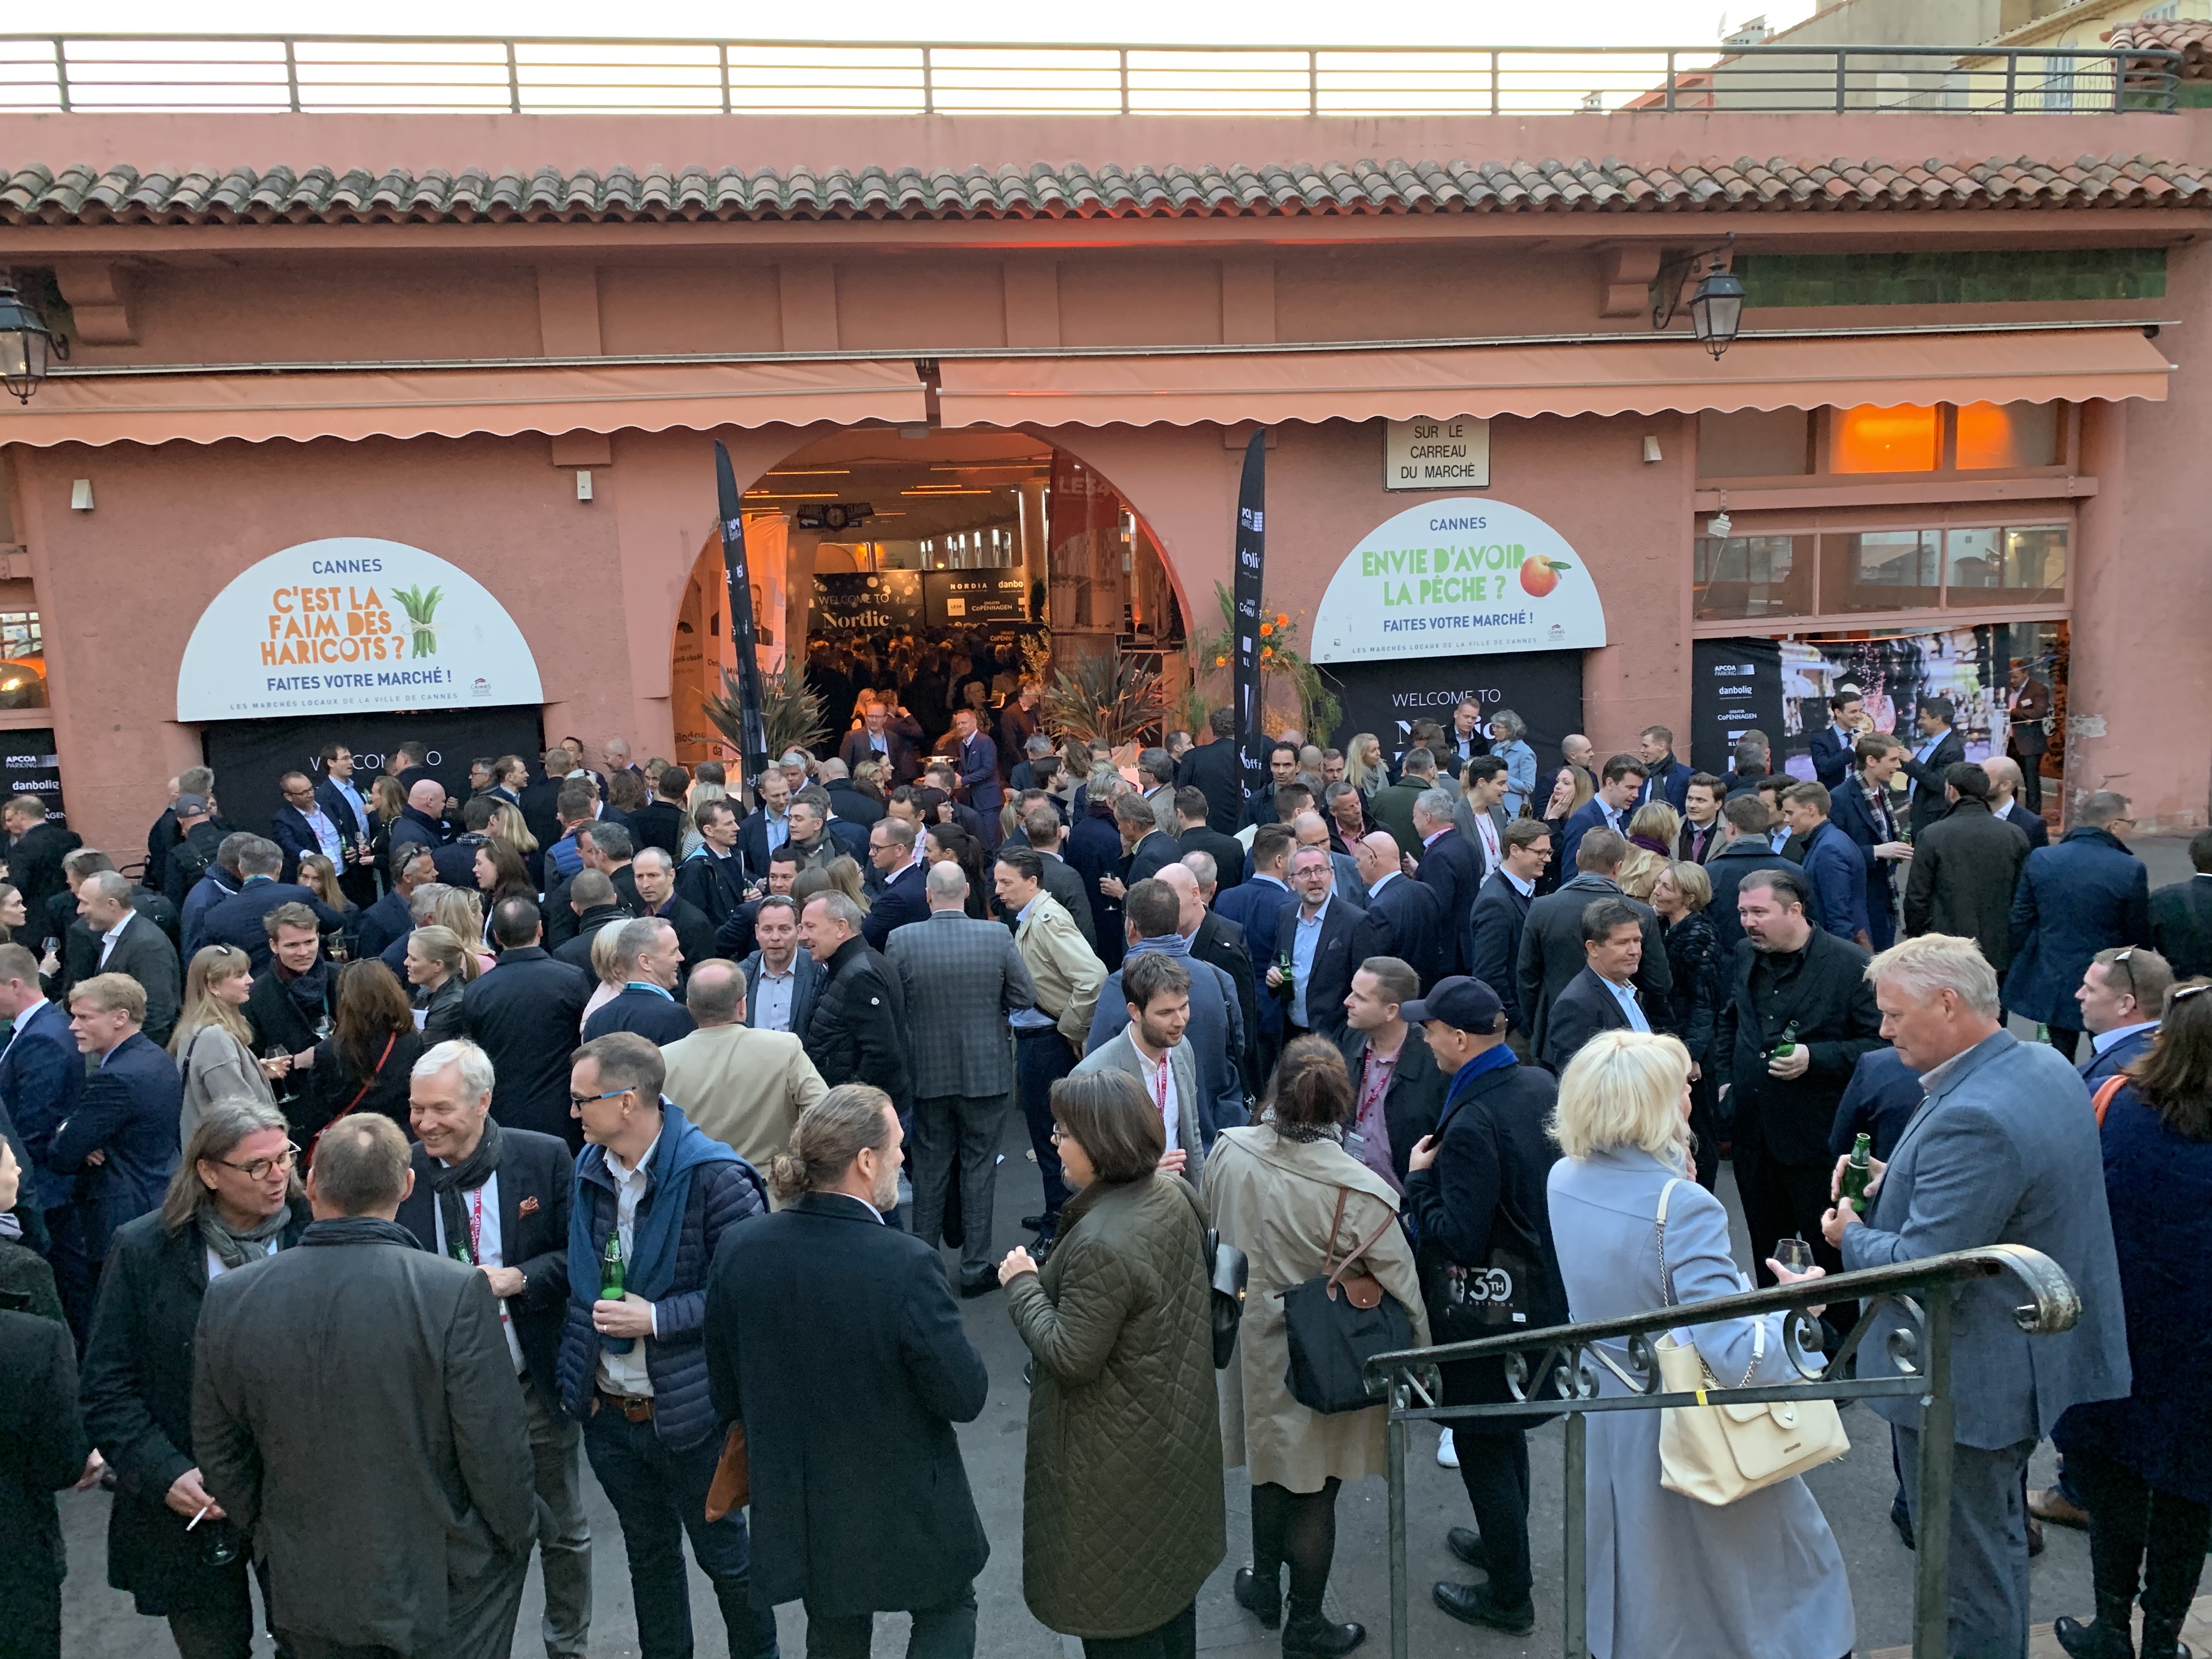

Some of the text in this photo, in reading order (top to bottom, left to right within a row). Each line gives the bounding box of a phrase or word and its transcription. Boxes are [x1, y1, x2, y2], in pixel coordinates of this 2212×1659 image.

[1415, 425, 1463, 438] SUR LE
[1410, 445, 1466, 459] CARREAU
[1401, 466, 1417, 478] DU
[1430, 517, 1487, 531] CANNES
[313, 559, 382, 574] CANNES
[1362, 544, 1525, 577] ENVIE D'AVOIR
[1385, 574, 1506, 606] LA PÊCHE ?
[273, 586, 382, 614] C'EST LA
[819, 594, 889, 605] WELCOME TO
[269, 611, 391, 640] FAIM DES
[822, 610, 890, 628] Nordic
[1384, 618, 1426, 631] FAITES
[1430, 616, 1469, 629] VOTRE
[1473, 610, 1526, 626] MARCHÉ
[261, 636, 404, 665] HARICOTS ?
[267, 675, 320, 691] FAITES
[324, 673, 374, 688] VOTRE
[379, 667, 443, 685] MARCHÉ
[1392, 689, 1500, 707] WELCOME TO
[1719, 686, 1752, 695] danbolig
